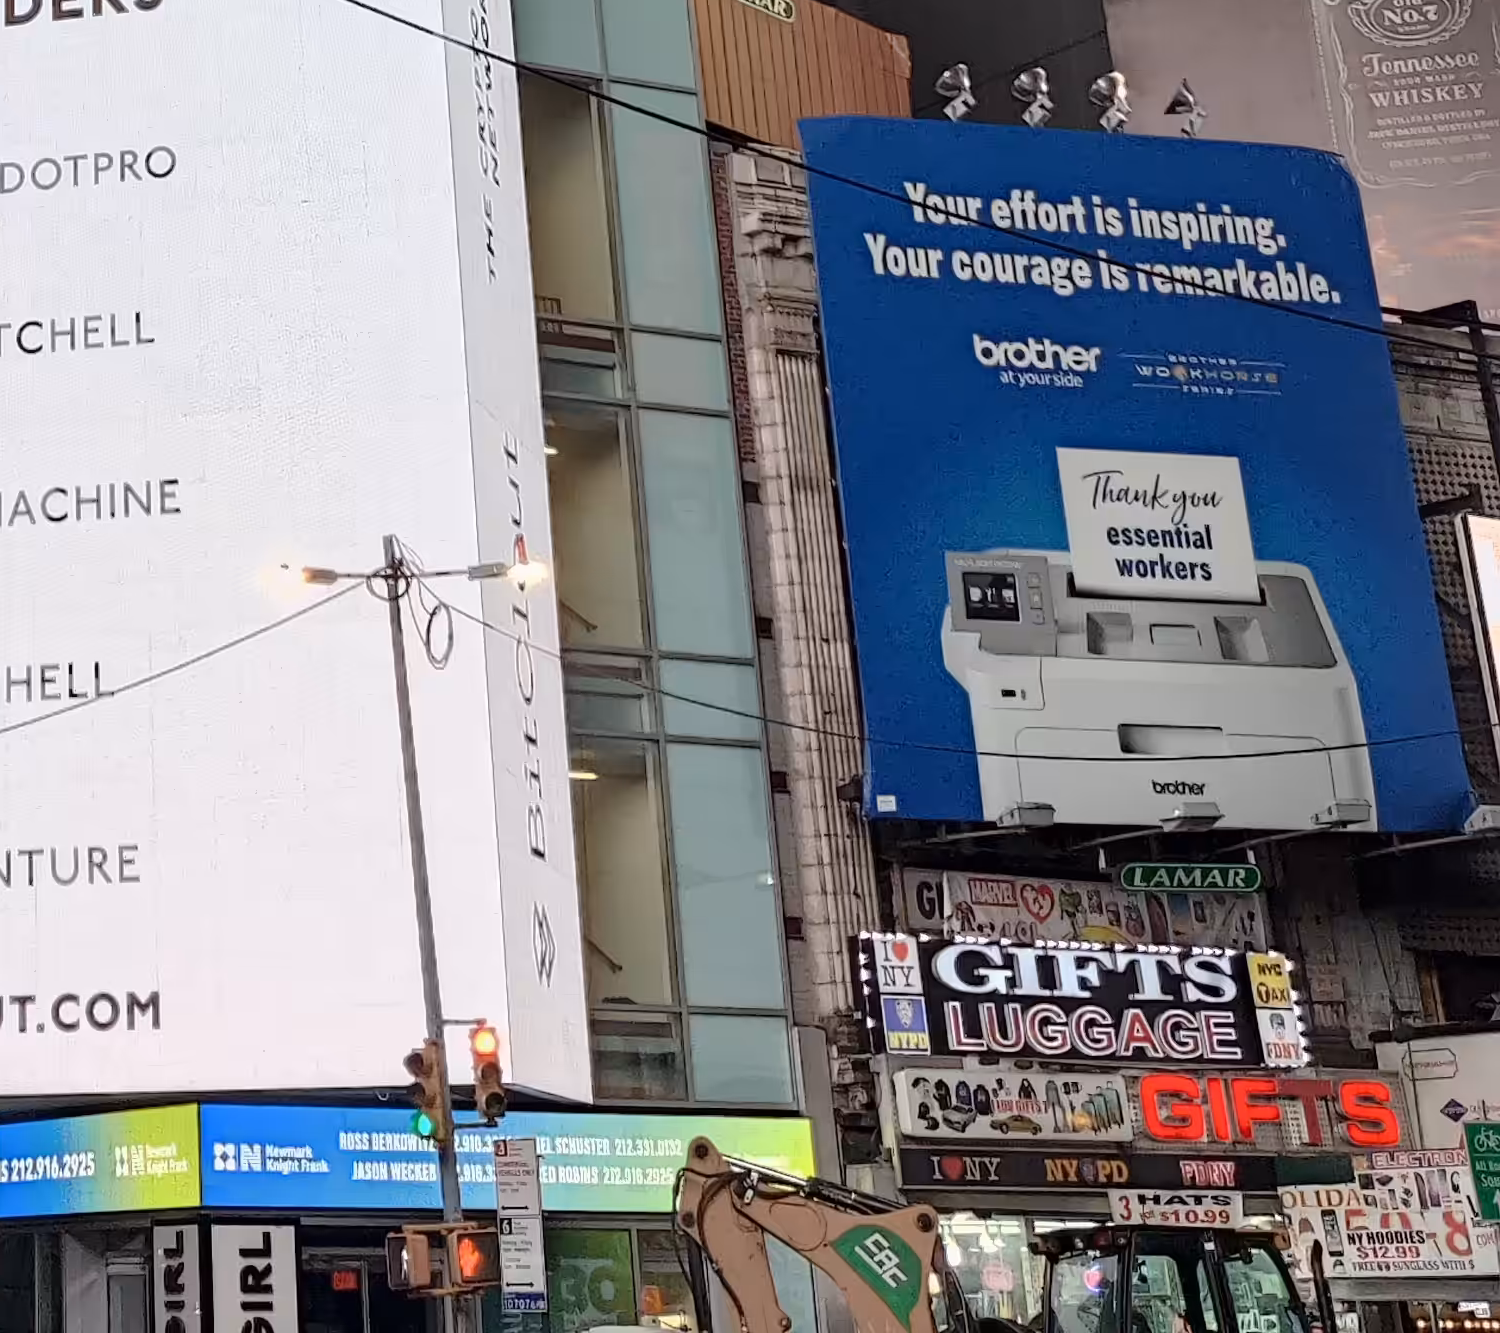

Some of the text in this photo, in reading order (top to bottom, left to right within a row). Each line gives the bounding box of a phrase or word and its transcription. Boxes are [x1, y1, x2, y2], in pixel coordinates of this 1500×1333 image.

[1361, 51, 1480, 78] Tennessee
[1368, 82, 1485, 109] WHISKEY
[902, 180, 1288, 256] Your effort is inspiring.
[484, 194, 498, 286] THE
[863, 232, 1342, 306] Your courage is remarkable.
[972, 333, 1102, 373] brother
[1051, 372, 1085, 389] side
[1081, 469, 1224, 527] Thank you
[1106, 523, 1214, 551] essential
[1115, 552, 1213, 582] workers
[1152, 778, 1206, 797] brother
[1132, 867, 1248, 888] LAMAR
[969, 880, 1017, 905] MARVEL
[881, 941, 915, 988] I NY
[931, 944, 1238, 1004] GIFTS
[1256, 961, 1283, 978] NYC
[1256, 981, 1289, 1004] TAXI
[889, 1032, 929, 1051] NYPD
[944, 1000, 1243, 1061] LUGGAGE
[1266, 1042, 1302, 1061] FDNY
[1138, 1072, 1401, 1147] GIFTS
[265, 1144, 314, 1160] Newmark
[339, 1131, 370, 1151] ROSS
[555, 1137, 611, 1156] SCHUSTER
[10, 1151, 96, 1182] 212.916.2925
[265, 1157, 331, 1174] Knight Frank
[930, 1156, 942, 1180] I
[964, 1158, 1001, 1181] NY
[1371, 1150, 1468, 1168] ELECTRON
[353, 1161, 388, 1181] JASON
[389, 1161, 438, 1182] WECKER
[558, 1166, 599, 1185] ROBINS
[1117, 1192, 1232, 1222] 3 HATS
[1159, 1208, 1231, 1226] $10.99
[1349, 1229, 1426, 1248] NY HOODIES
[1357, 1245, 1421, 1260] $12.99
[1352, 1260, 1377, 1272] FREE
[1392, 1259, 1440, 1272] SUNGLASS
[1442, 1259, 1467, 1271] WITH
